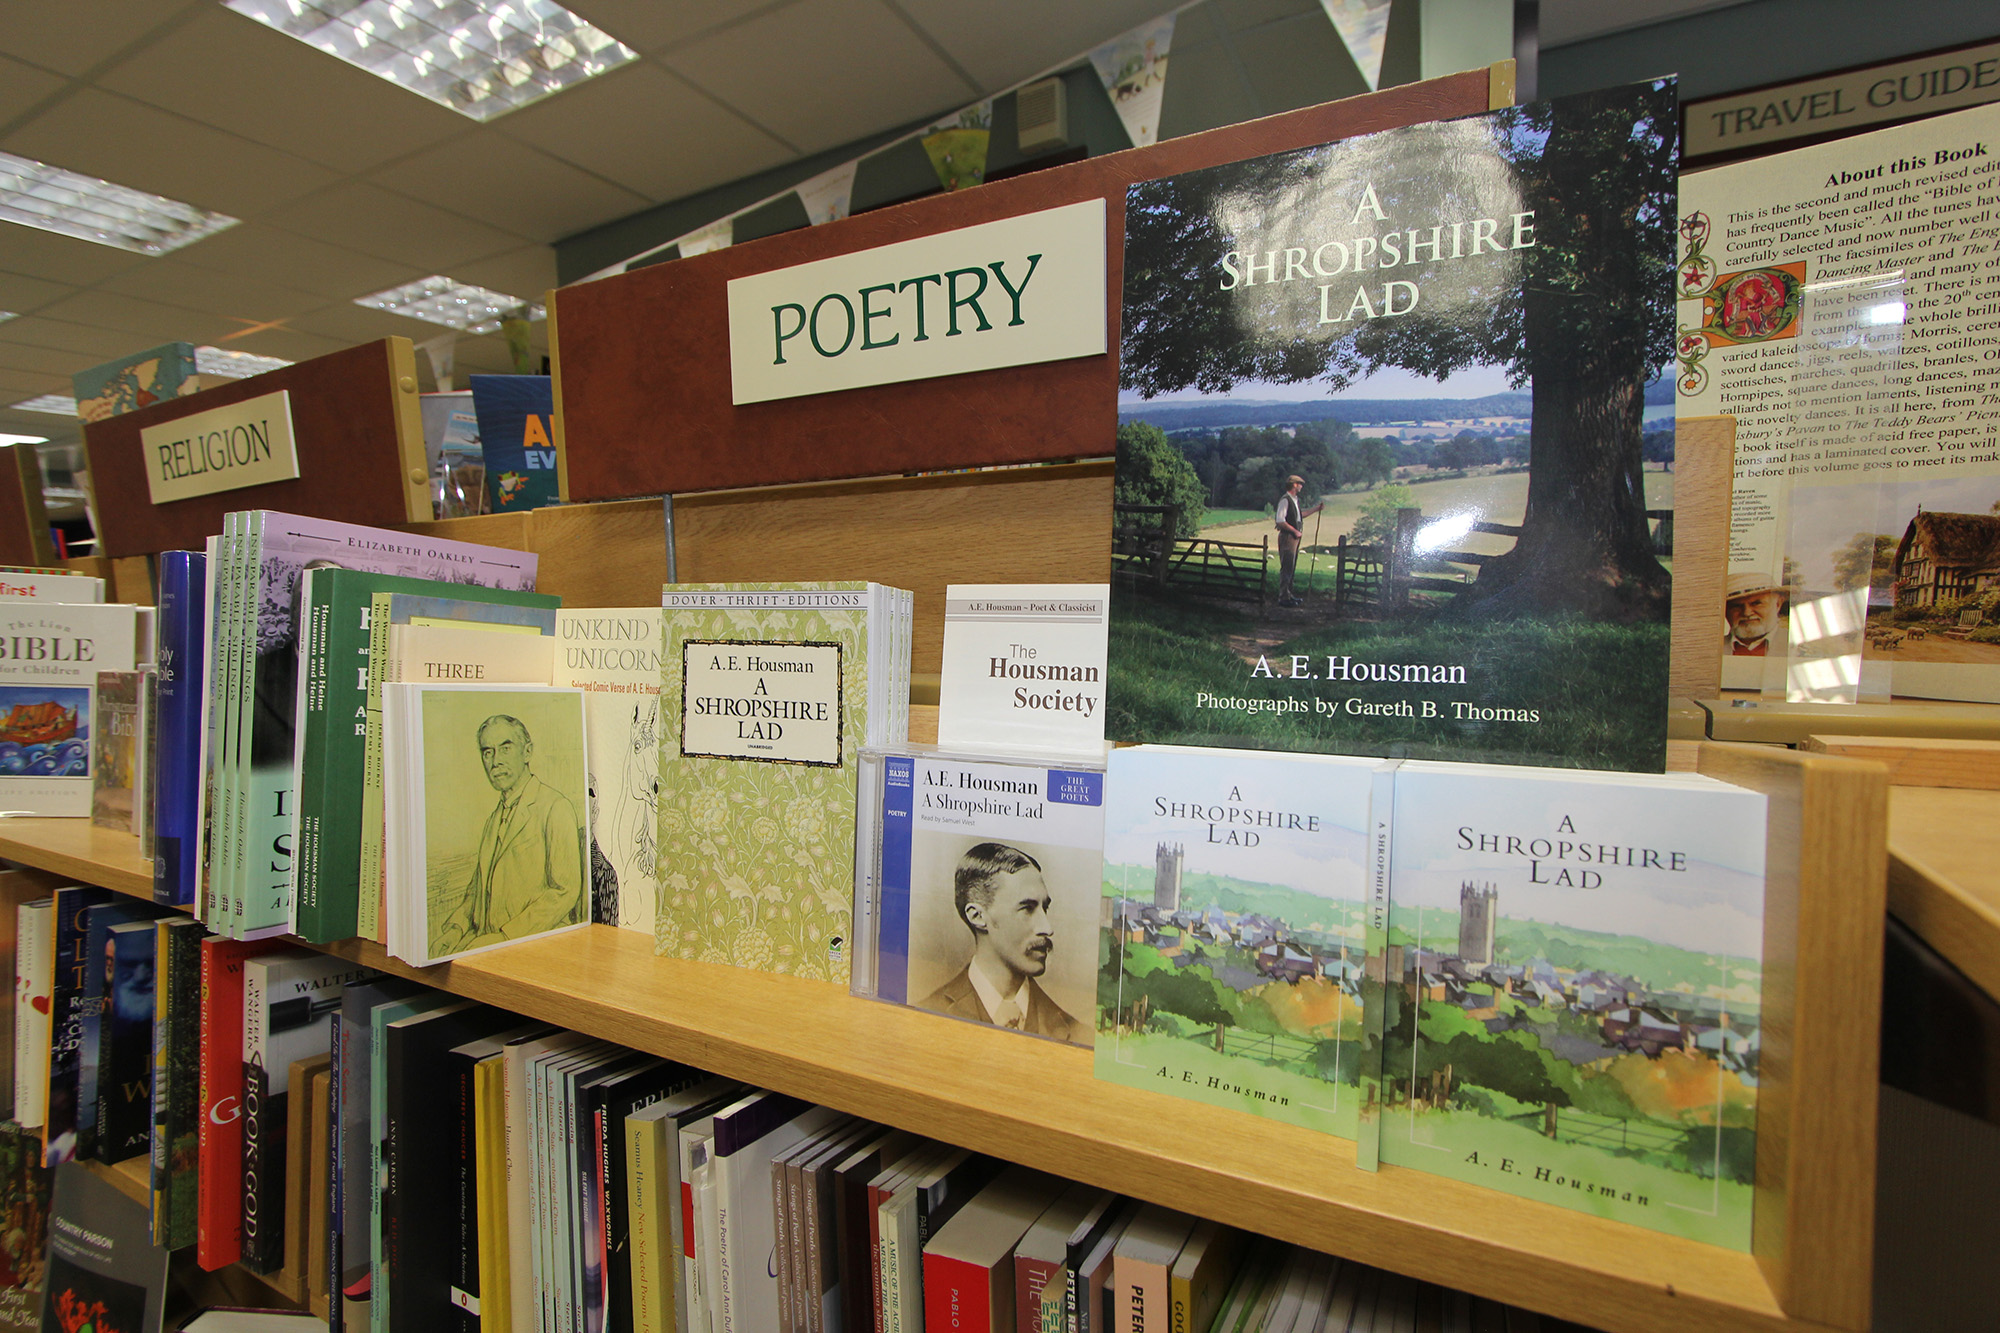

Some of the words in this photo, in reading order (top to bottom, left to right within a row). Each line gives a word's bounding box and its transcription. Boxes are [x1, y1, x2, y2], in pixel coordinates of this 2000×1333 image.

[1711, 88, 1856, 138] TRAVEL
[1824, 164, 1885, 189] About
[1890, 156, 1927, 174] this
[1933, 142, 1988, 166] Book
[1350, 181, 1388, 225] A
[1727, 210, 1754, 224] This
[1758, 207, 1768, 219] is
[1772, 204, 1791, 215] the
[1795, 192, 1840, 211] second
[1843, 186, 1868, 201] and
[1872, 179, 1911, 196] much
[1915, 166, 1968, 187] revised
[1727, 226, 1747, 239] has
[1751, 214, 1814, 234] frequently
[1818, 207, 1849, 221] been
[1853, 196, 1894, 214] called
[1898, 194, 1920, 206] the
[1977, 176, 1996, 190] of
[1726, 236, 1776, 253] Country
[1779, 227, 1820, 243] Dance
[1881, 210, 1903, 225] All
[1907, 207, 1929, 220] the
[1933, 199, 1972, 215] tunes
[1219, 209, 1538, 292] SHROPSHIRE
[770, 253, 1043, 366] POETRY
[1317, 280, 1421, 325] LAD
[158, 419, 272, 481] RELIGION
[347, 537, 422, 557] ELIZABETH
[427, 549, 475, 565] OAKLEY
[0, 581, 37, 598] first
[247, 532, 258, 627] INSEPARABLE
[671, 595, 717, 606] DOVER
[726, 595, 780, 606] THRIFT
[788, 594, 860, 606] EDITIONS
[968, 603, 985, 611] A.E.
[986, 603, 1022, 612] Housman
[1030, 603, 1047, 612] Poet
[1049, 603, 1056, 612] &
[1058, 603, 1097, 613] Classicist
[39, 618, 72, 633] Lion
[311, 606, 320, 656] Housman
[320, 603, 329, 655] Housman
[371, 620, 380, 656] Westerly
[562, 619, 650, 641] UNKIND
[709, 655, 742, 672] A.E.
[746, 656, 814, 674] Housman
[1009, 644, 1037, 660] The
[22, 664, 80, 676] Children
[244, 635, 253, 703] SIBLINGS
[370, 657, 378, 698] Wanderer
[424, 661, 485, 680] THREE
[988, 657, 1099, 683] Housman
[1250, 653, 1283, 680] A.
[1289, 655, 1320, 681] E.
[1325, 654, 1468, 685] Housman
[317, 680, 326, 711] Heine
[593, 681, 609, 693] Comic
[610, 682, 626, 694] Verse
[626, 683, 632, 694] of
[633, 683, 639, 694] A.
[640, 683, 646, 695] E.
[753, 677, 769, 696] A
[1013, 686, 1098, 718] Society
[694, 696, 829, 721] SHROPSHIRE
[1195, 691, 1310, 716] Photographs
[1315, 696, 1339, 720] by
[1344, 697, 1414, 718] Gareth
[1420, 700, 1446, 719] B.
[1450, 701, 1541, 724] Thomas
[737, 720, 783, 741] LAD
[888, 769, 910, 778] NAXOS
[922, 769, 954, 788] A.E.
[958, 772, 1039, 795] Housman
[1060, 784, 1090, 793] GREAT
[1066, 776, 1085, 785] THE
[922, 792, 932, 808] A
[936, 793, 1012, 817] Shropshire
[1015, 801, 1044, 820] Lad
[1060, 792, 1090, 802] POETS
[1228, 785, 1243, 802] A
[887, 809, 907, 818] POETRY
[920, 814, 934, 822] Read
[934, 815, 942, 824] by
[942, 816, 961, 825] Samuel
[961, 818, 976, 826] West
[1154, 796, 1320, 832] SHROPSHIRE
[1556, 815, 1577, 834] A
[1206, 823, 1260, 848] LAD
[1457, 826, 1687, 872] SHROPSHIRE
[303, 832, 311, 871] HOUSMAN
[311, 832, 319, 874] HOUSMAN
[1375, 833, 1386, 903] SHROPSHIRE
[1529, 859, 1602, 889] LAD
[1374, 907, 1383, 930] LAD
[293, 969, 365, 993] WALTER
[253, 988, 261, 1044] WALTER
[1156, 1065, 1174, 1080] A.
[1182, 1070, 1199, 1085] E.
[1207, 1076, 1289, 1106] Housman
[245, 1076, 260, 1158] BOOK
[603, 1142, 611, 1184] HUGHES
[634, 1129, 642, 1168] Seamus
[635, 1169, 644, 1210] Heaney
[1465, 1151, 1488, 1167] A.
[1500, 1158, 1521, 1176] E.
[1534, 1166, 1650, 1206] Housman
[244, 1170, 259, 1239] GOD
[55, 1216, 83, 1239] COUNTRY
[81, 1230, 114, 1250] PARSON
[719, 1225, 728, 1255] Poetry
[889, 1238, 896, 1246] A
[638, 1238, 647, 1290] Selected
[721, 1255, 728, 1267] of
[889, 1248, 897, 1277] MUSIC
[721, 1266, 729, 1290] Carol
[890, 1276, 897, 1291] OF
[1028, 1269, 1047, 1300] THE
[1066, 1269, 1076, 1312] PETER
[640, 1290, 648, 1319] Poems
[951, 1287, 960, 1328] PABLO
[1131, 1284, 1145, 1333] PETER
